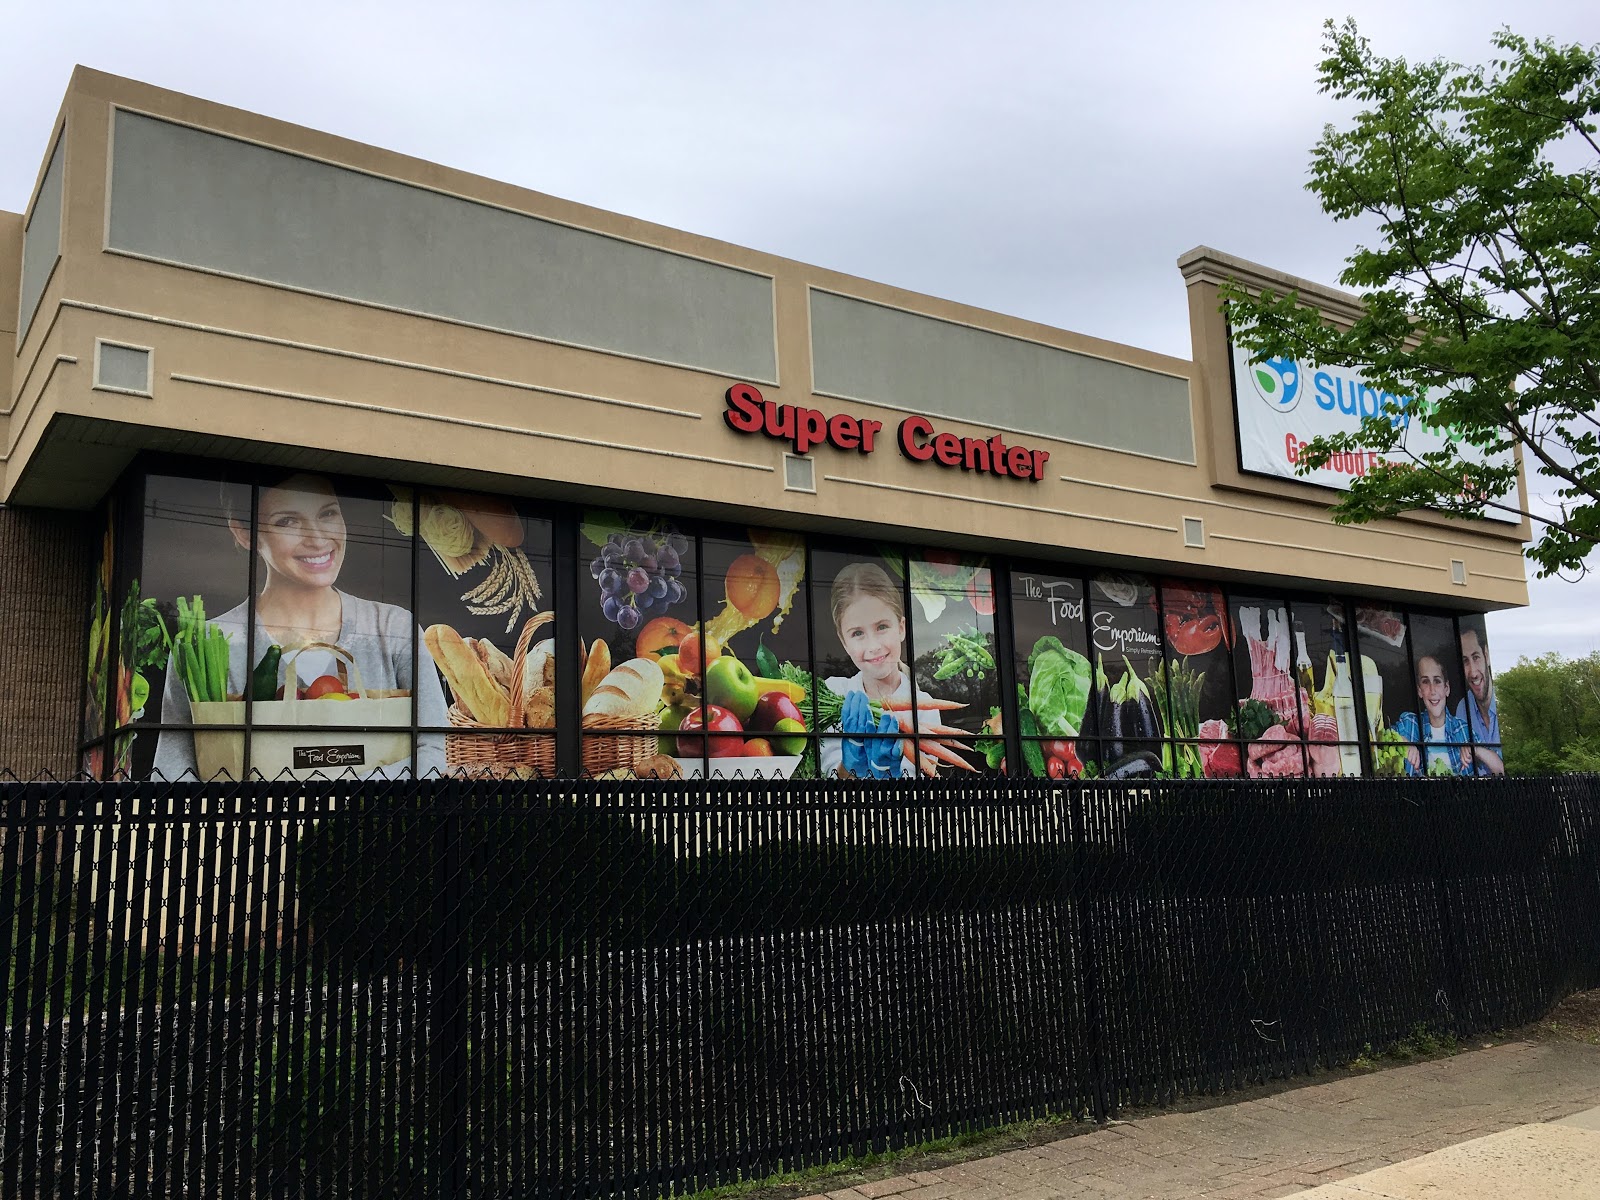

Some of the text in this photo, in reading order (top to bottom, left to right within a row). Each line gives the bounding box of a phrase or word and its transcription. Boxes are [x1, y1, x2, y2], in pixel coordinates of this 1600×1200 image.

[723, 383, 1050, 481] Super Center
[1019, 576, 1084, 626] The Food
[1092, 611, 1161, 652] Emporium
[306, 749, 324, 764] Food
